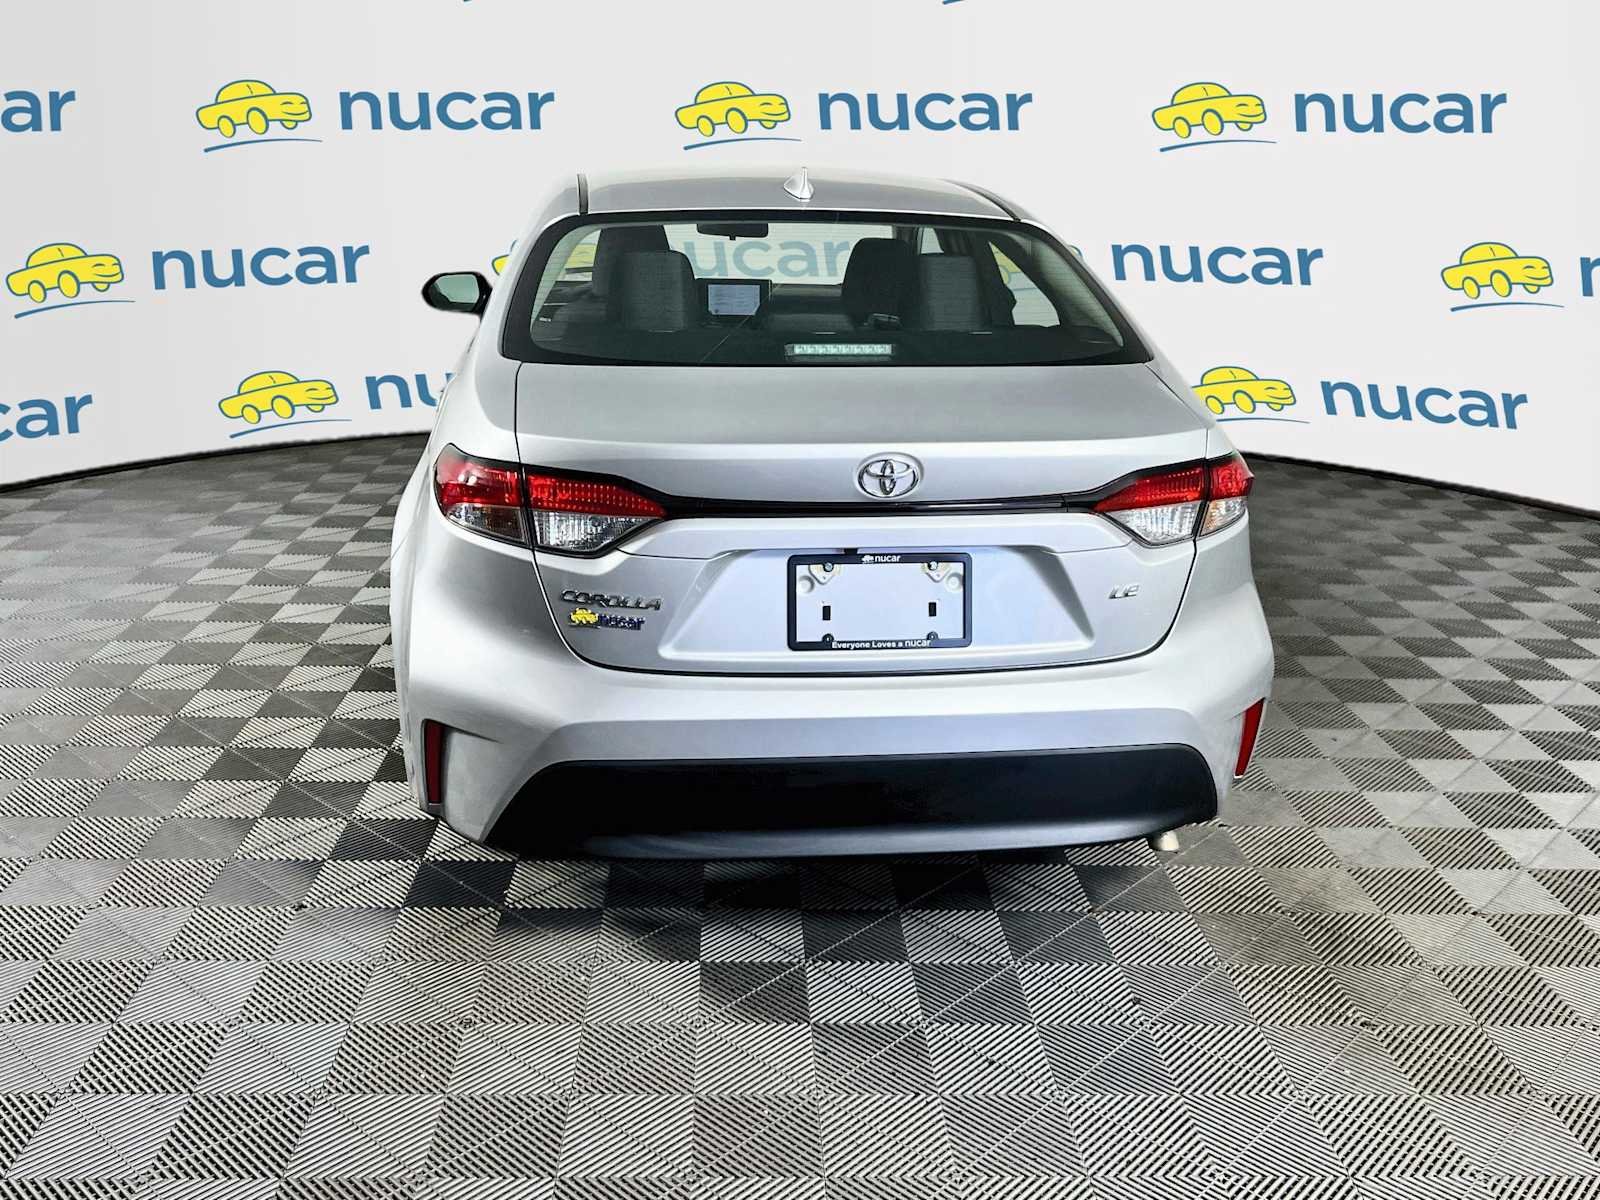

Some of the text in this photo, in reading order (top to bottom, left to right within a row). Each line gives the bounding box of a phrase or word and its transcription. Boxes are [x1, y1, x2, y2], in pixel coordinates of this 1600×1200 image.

[339, 91, 556, 131] nucar
[818, 92, 1033, 132] nucar
[1295, 92, 1508, 134] nucar
[151, 244, 370, 290] nucar
[1111, 243, 1324, 286] nucar
[1321, 381, 1529, 430] nucar
[874, 554, 901, 563] nucar
[561, 589, 663, 611] COROLLA
[1109, 584, 1140, 599] LE
[598, 613, 645, 631] nucar
[831, 641, 870, 650] Everyone
[871, 640, 897, 648] Loves
[904, 639, 932, 648] nucar
